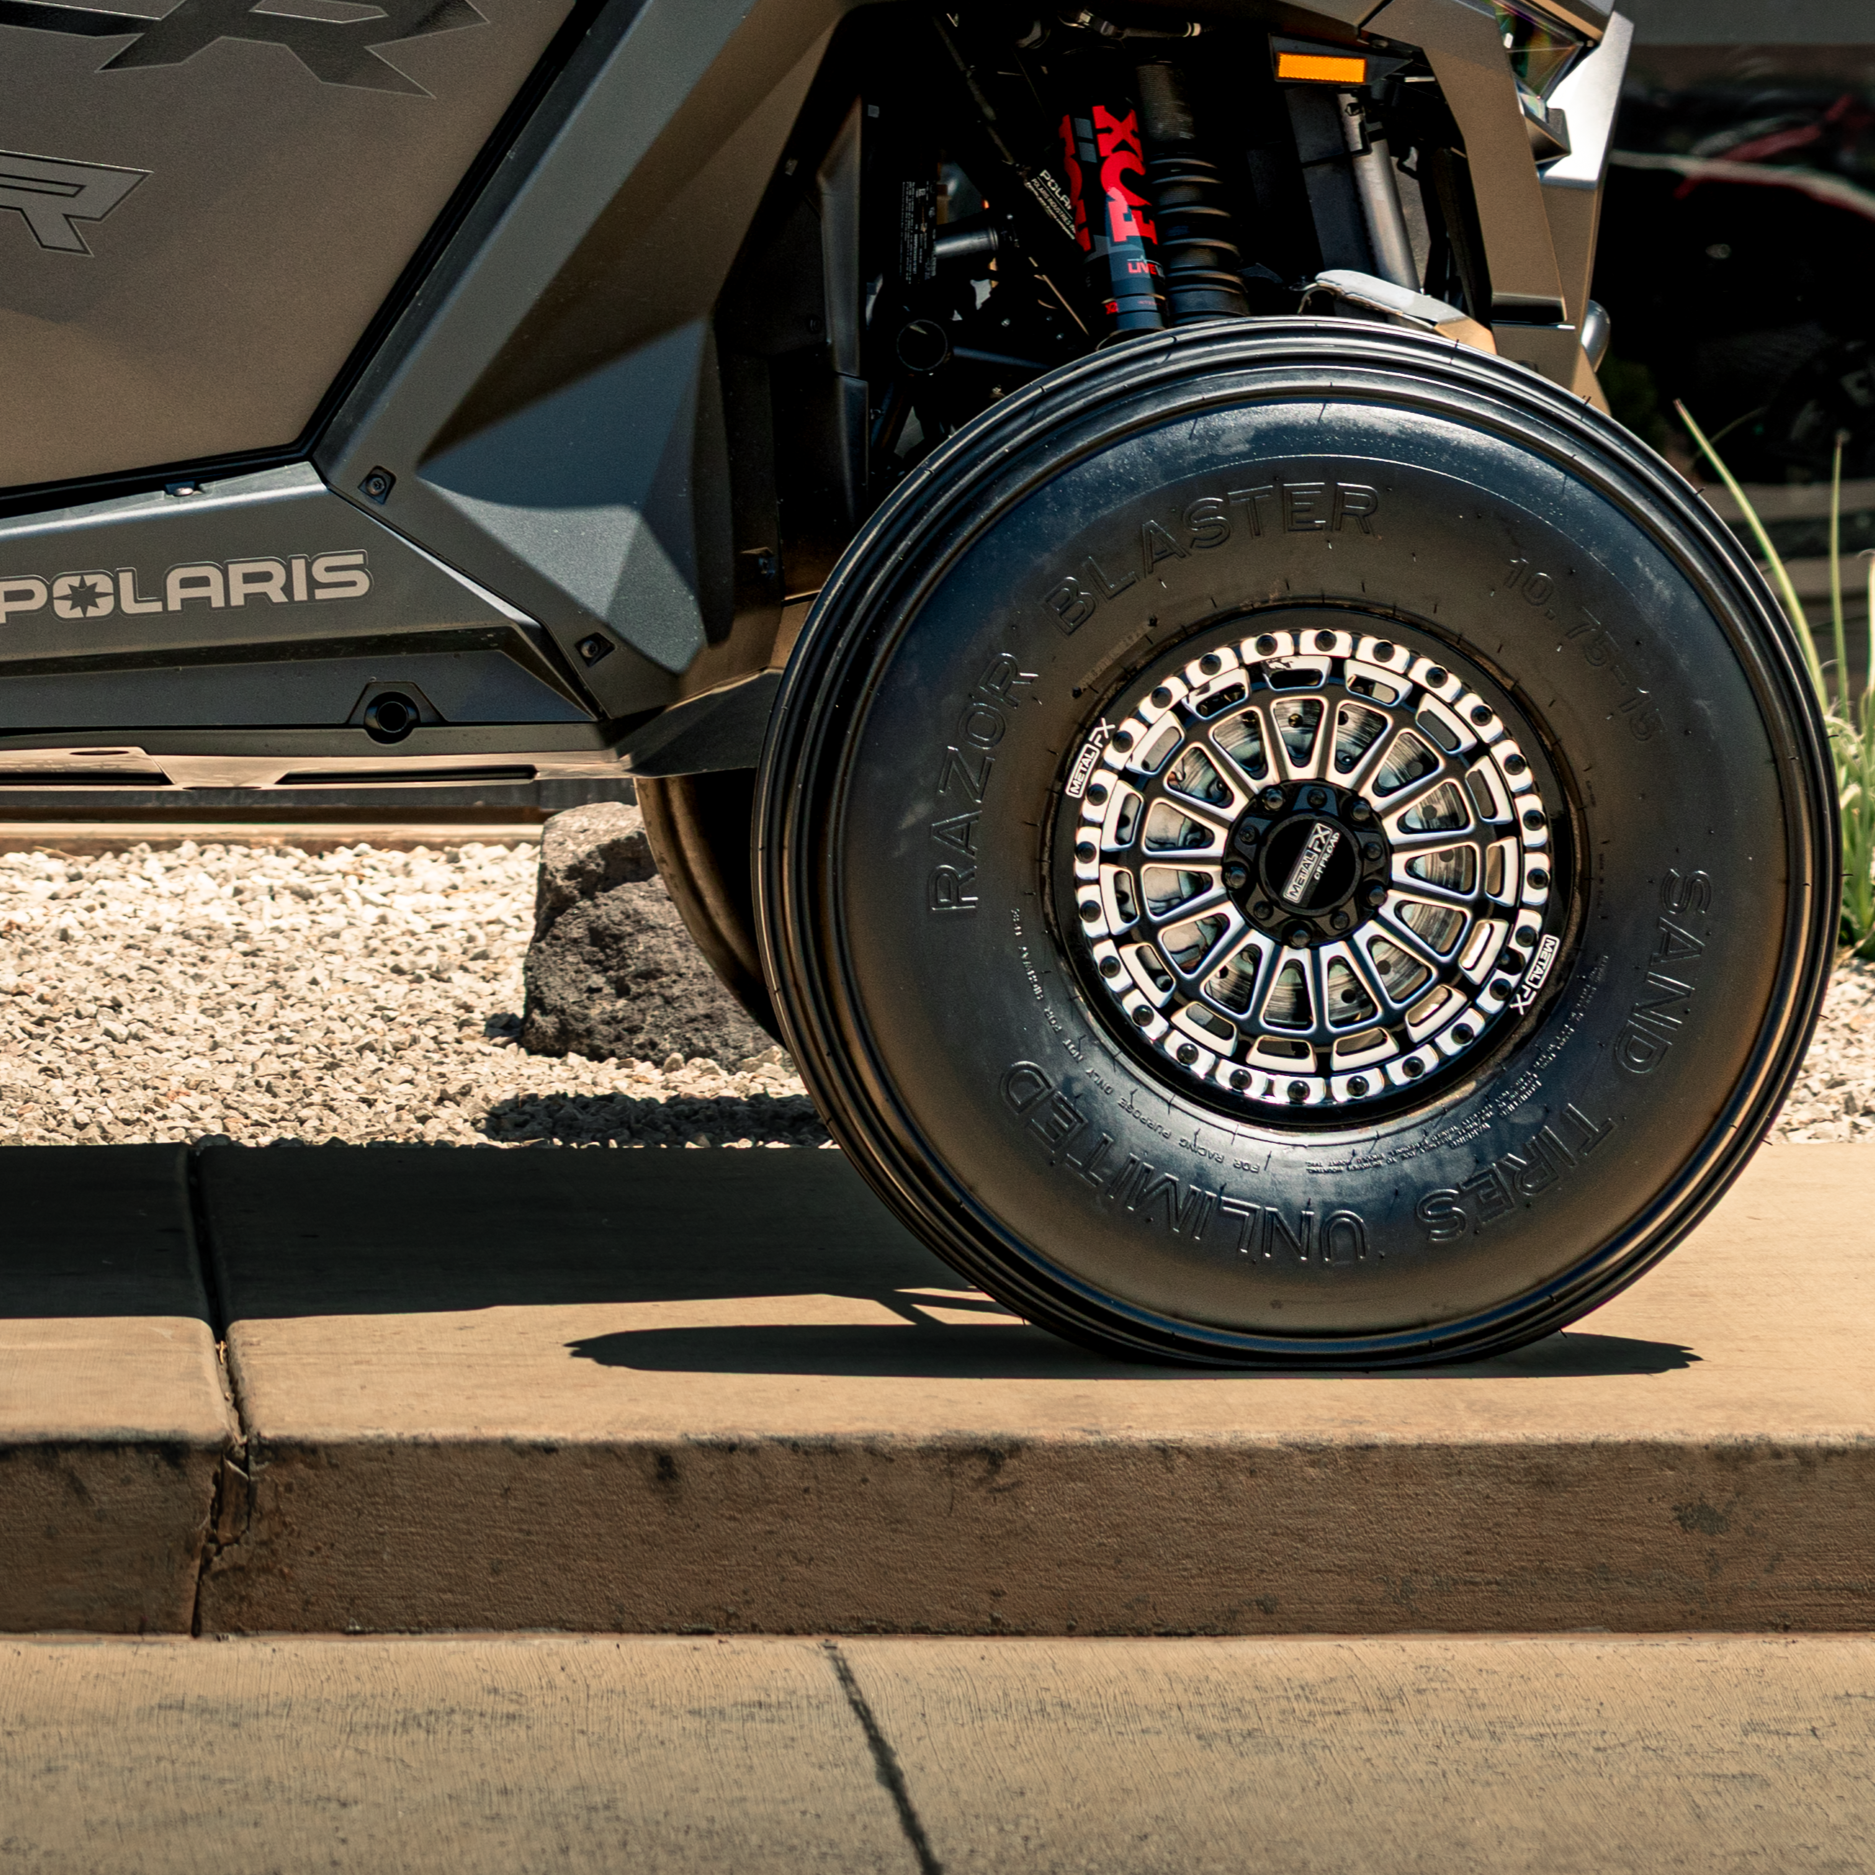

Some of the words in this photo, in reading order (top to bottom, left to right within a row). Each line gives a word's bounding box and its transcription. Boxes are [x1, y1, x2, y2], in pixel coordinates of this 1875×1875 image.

[1092, 104, 1159, 246] FOX
[929, 652, 1039, 912] RAZOR
[1038, 481, 1379, 637] BLASTER
[1068, 747, 1098, 796] METAL
[1088, 717, 1116, 748] FX
[1288, 852, 1315, 899] METAL
[1308, 824, 1331, 853] FX
[1313, 831, 1341, 881] OFFROAD
[1528, 937, 1557, 982] METAL
[1614, 867, 1713, 1075] SAND
[1044, 1005, 1063, 1033] FOR
[1509, 985, 1538, 1016] FX
[1063, 1038, 1084, 1063] NOT
[1085, 1068, 1114, 1096] ONLY
[1118, 1096, 1172, 1140] PURPOSE
[999, 1061, 1369, 1263] UNLIMITED
[1178, 1138, 1224, 1164] RACING
[1233, 1158, 1260, 1174] FOR
[1416, 1101, 1617, 1242] TIRES
